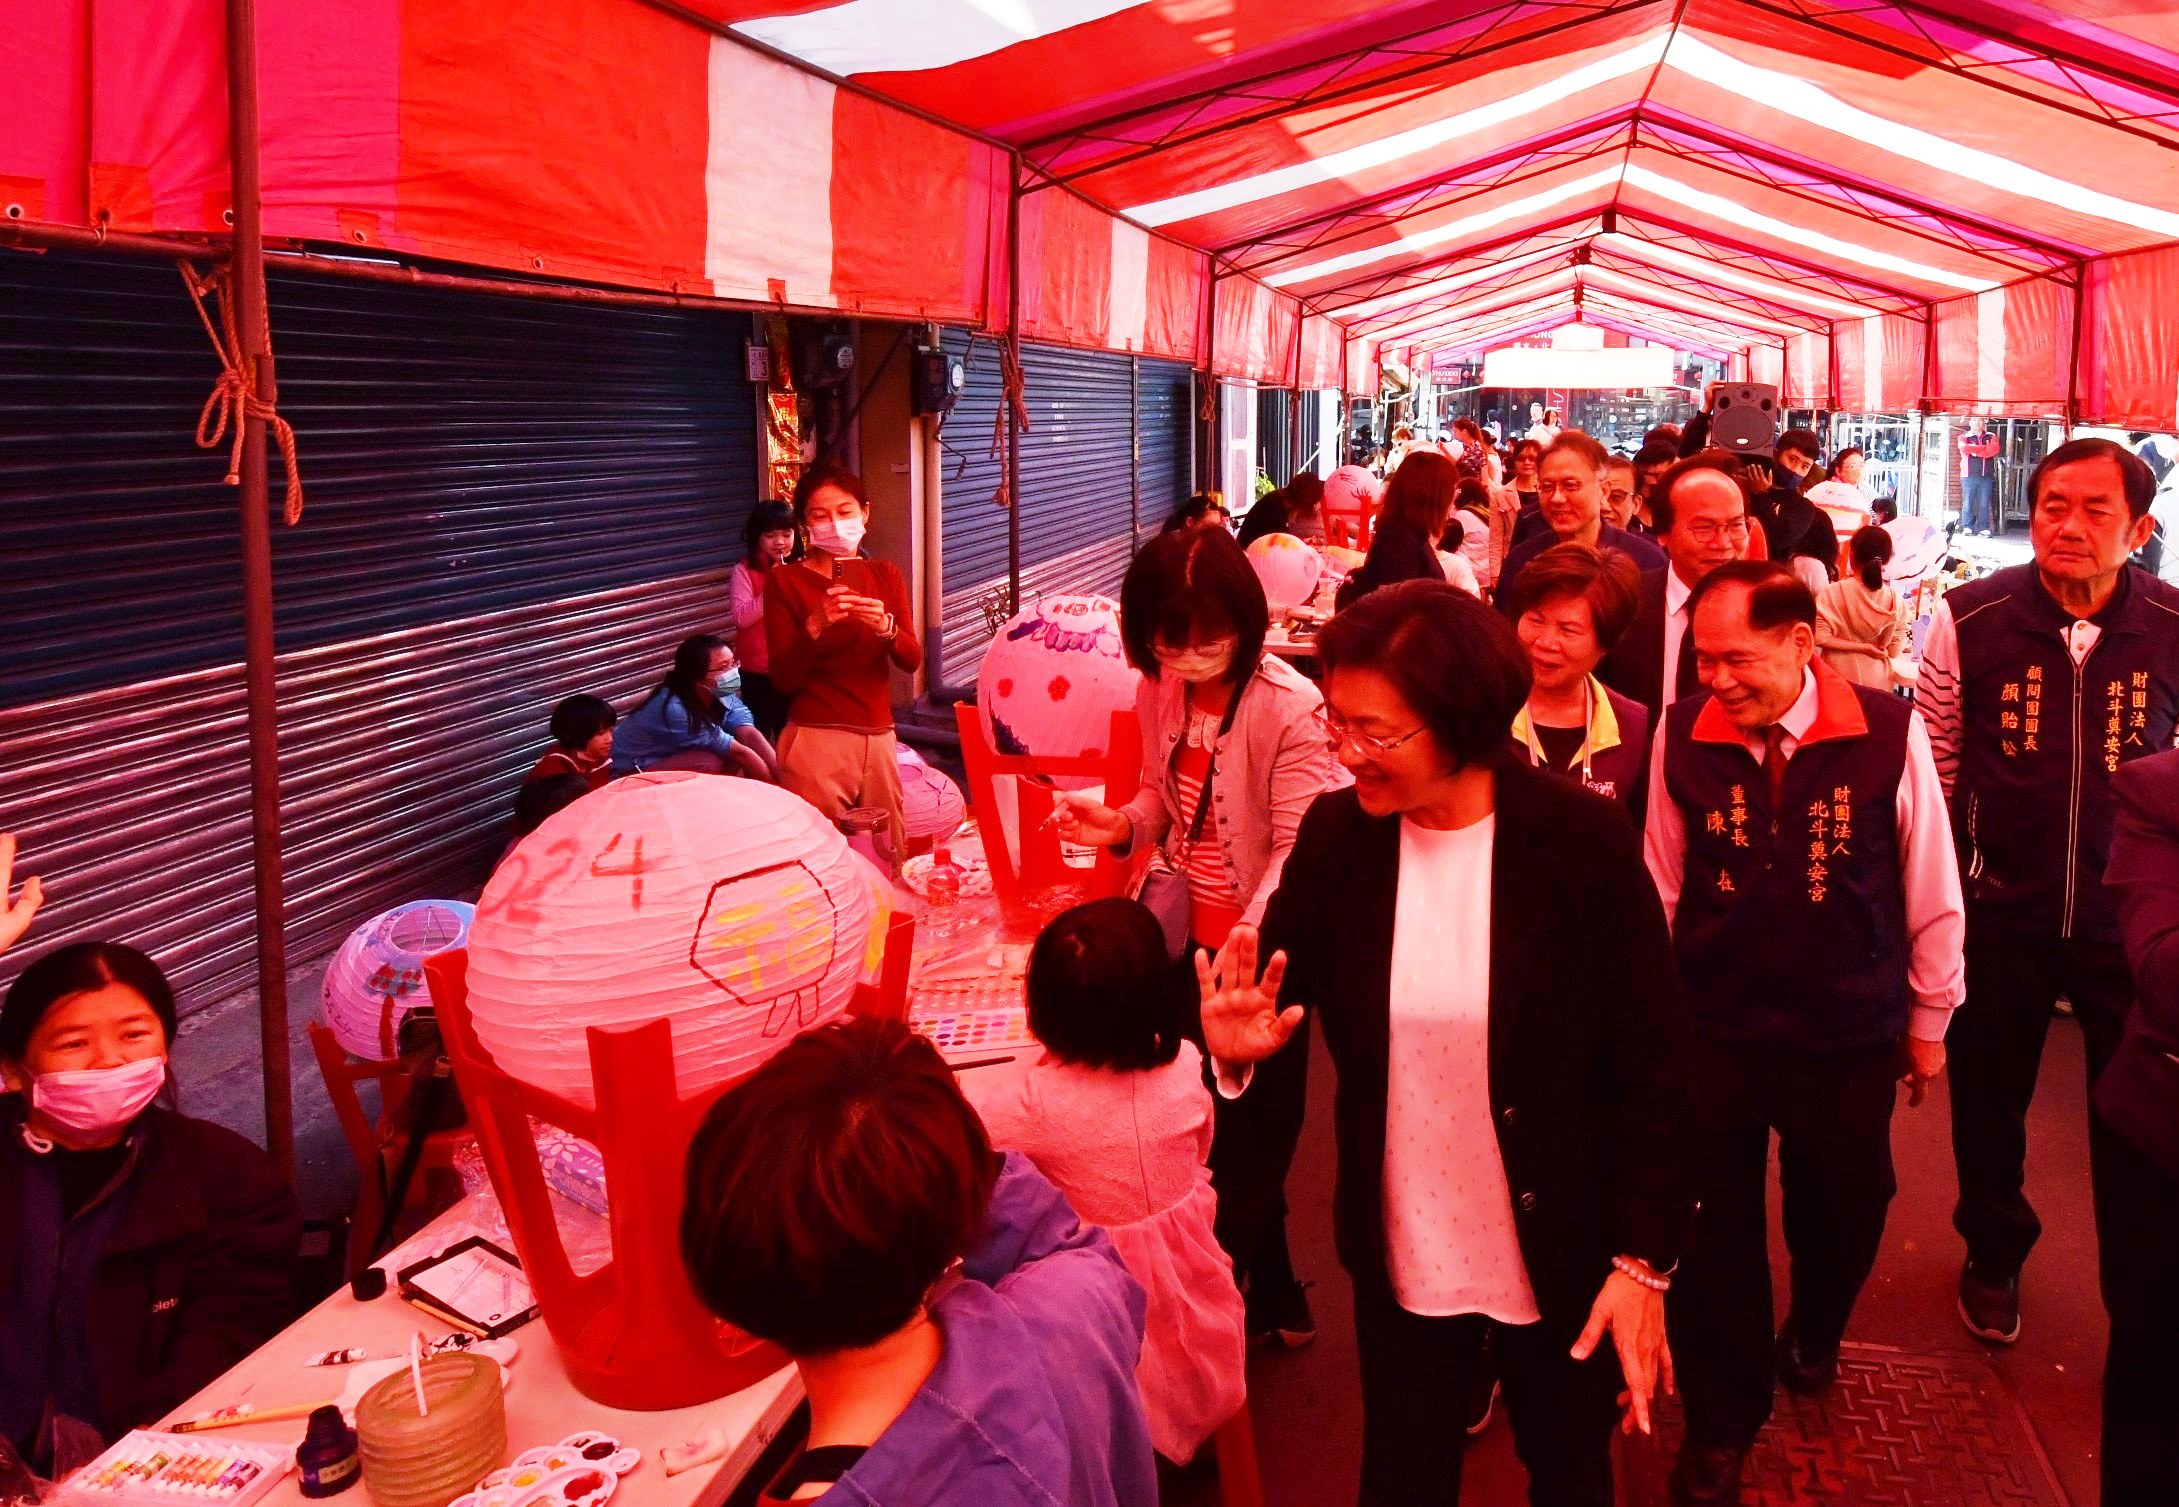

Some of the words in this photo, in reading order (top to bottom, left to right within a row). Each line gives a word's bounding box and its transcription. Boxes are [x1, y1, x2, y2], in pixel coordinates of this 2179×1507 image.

[2103, 680, 2125, 772] 北斗奠安宮
[2123, 671, 2149, 746] 財團法人
[1730, 784, 1750, 848] 董事長
[1807, 799, 1830, 902] 北斗奠安宮
[1831, 785, 1851, 856] 財團法人
